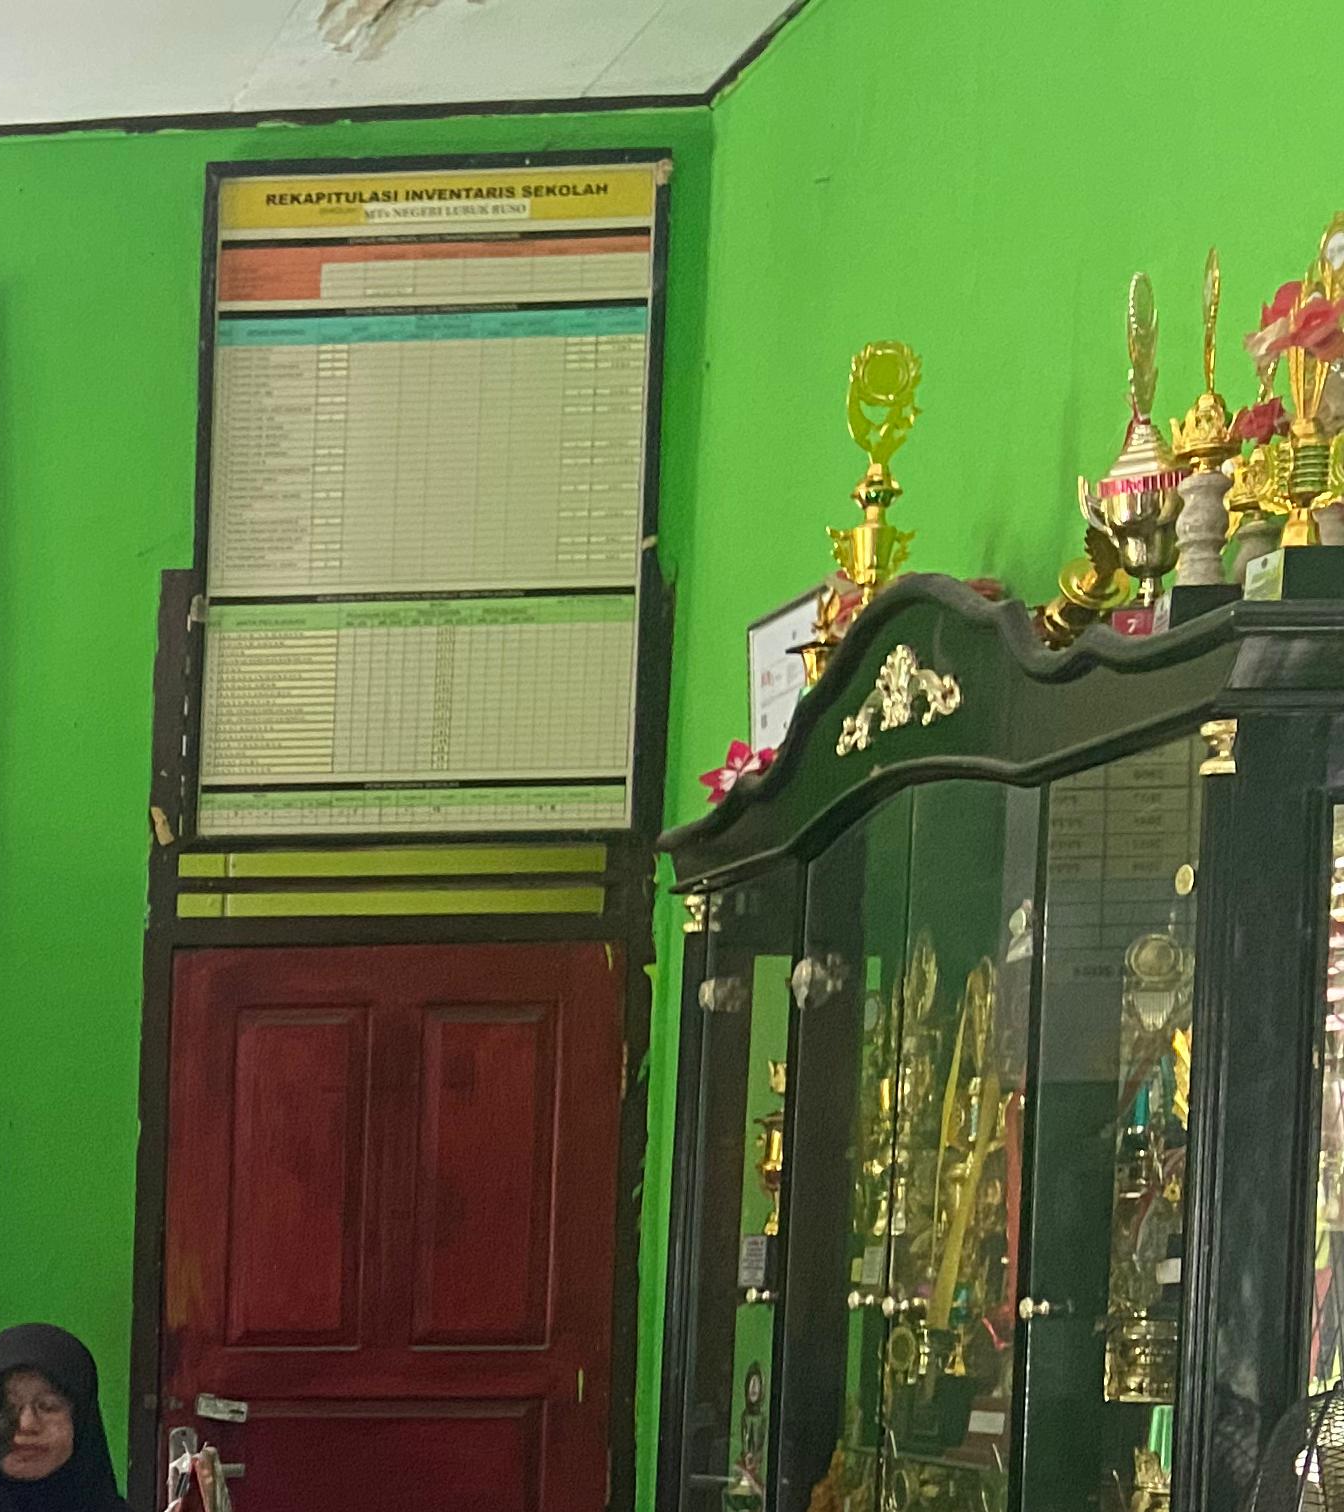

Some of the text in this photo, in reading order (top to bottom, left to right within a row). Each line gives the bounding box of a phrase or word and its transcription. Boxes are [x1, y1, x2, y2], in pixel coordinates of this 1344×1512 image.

[266, 182, 608, 206] REKAPITULASI INVENTARIS SEKOLAH
